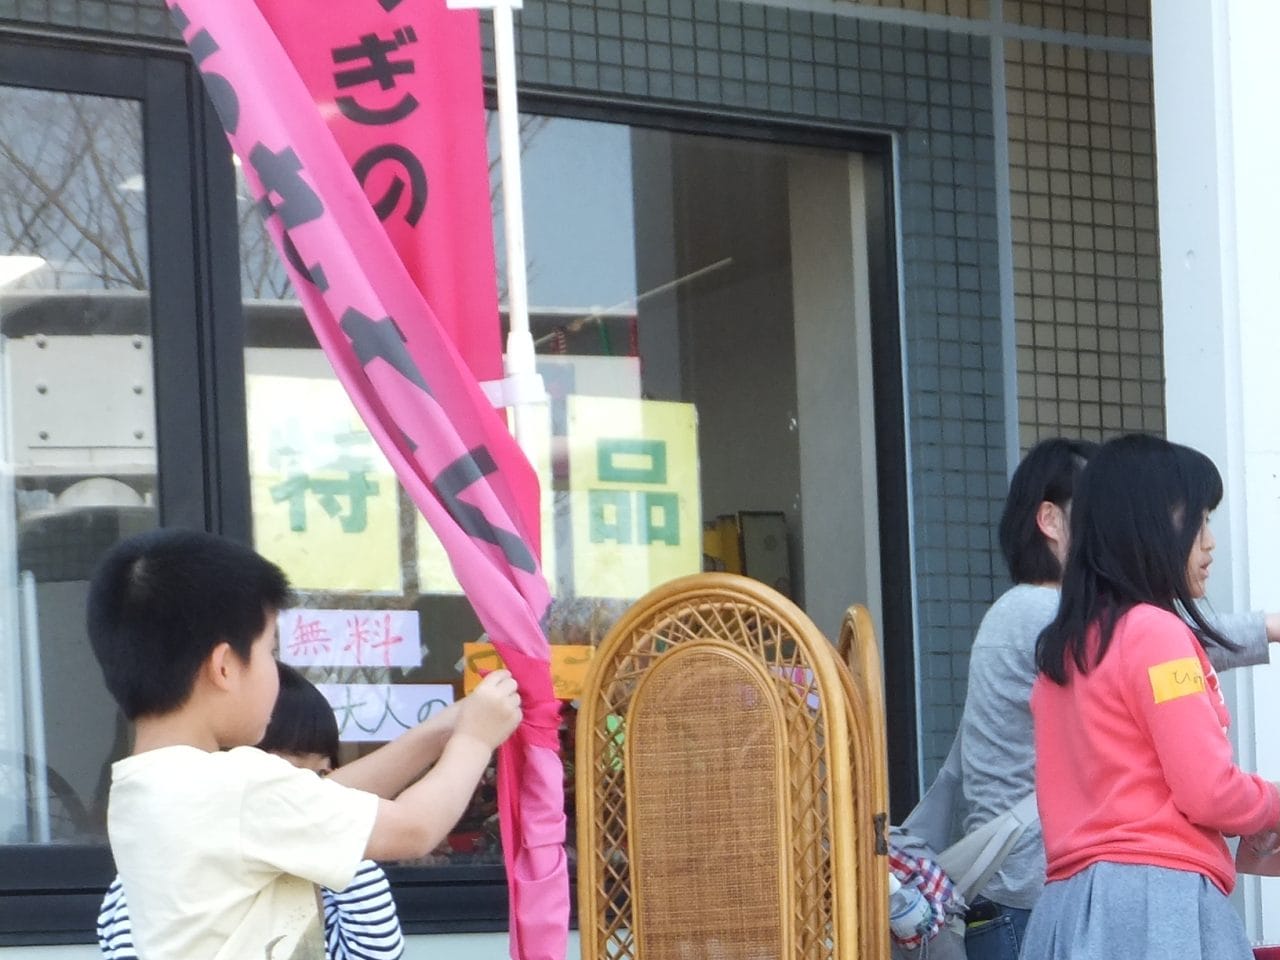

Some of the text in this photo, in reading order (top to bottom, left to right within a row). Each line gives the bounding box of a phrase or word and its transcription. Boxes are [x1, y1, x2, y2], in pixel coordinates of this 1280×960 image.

[331, 0, 428, 228] ぎの
[589, 439, 680, 547] 品
[288, 613, 404, 666] 無料
